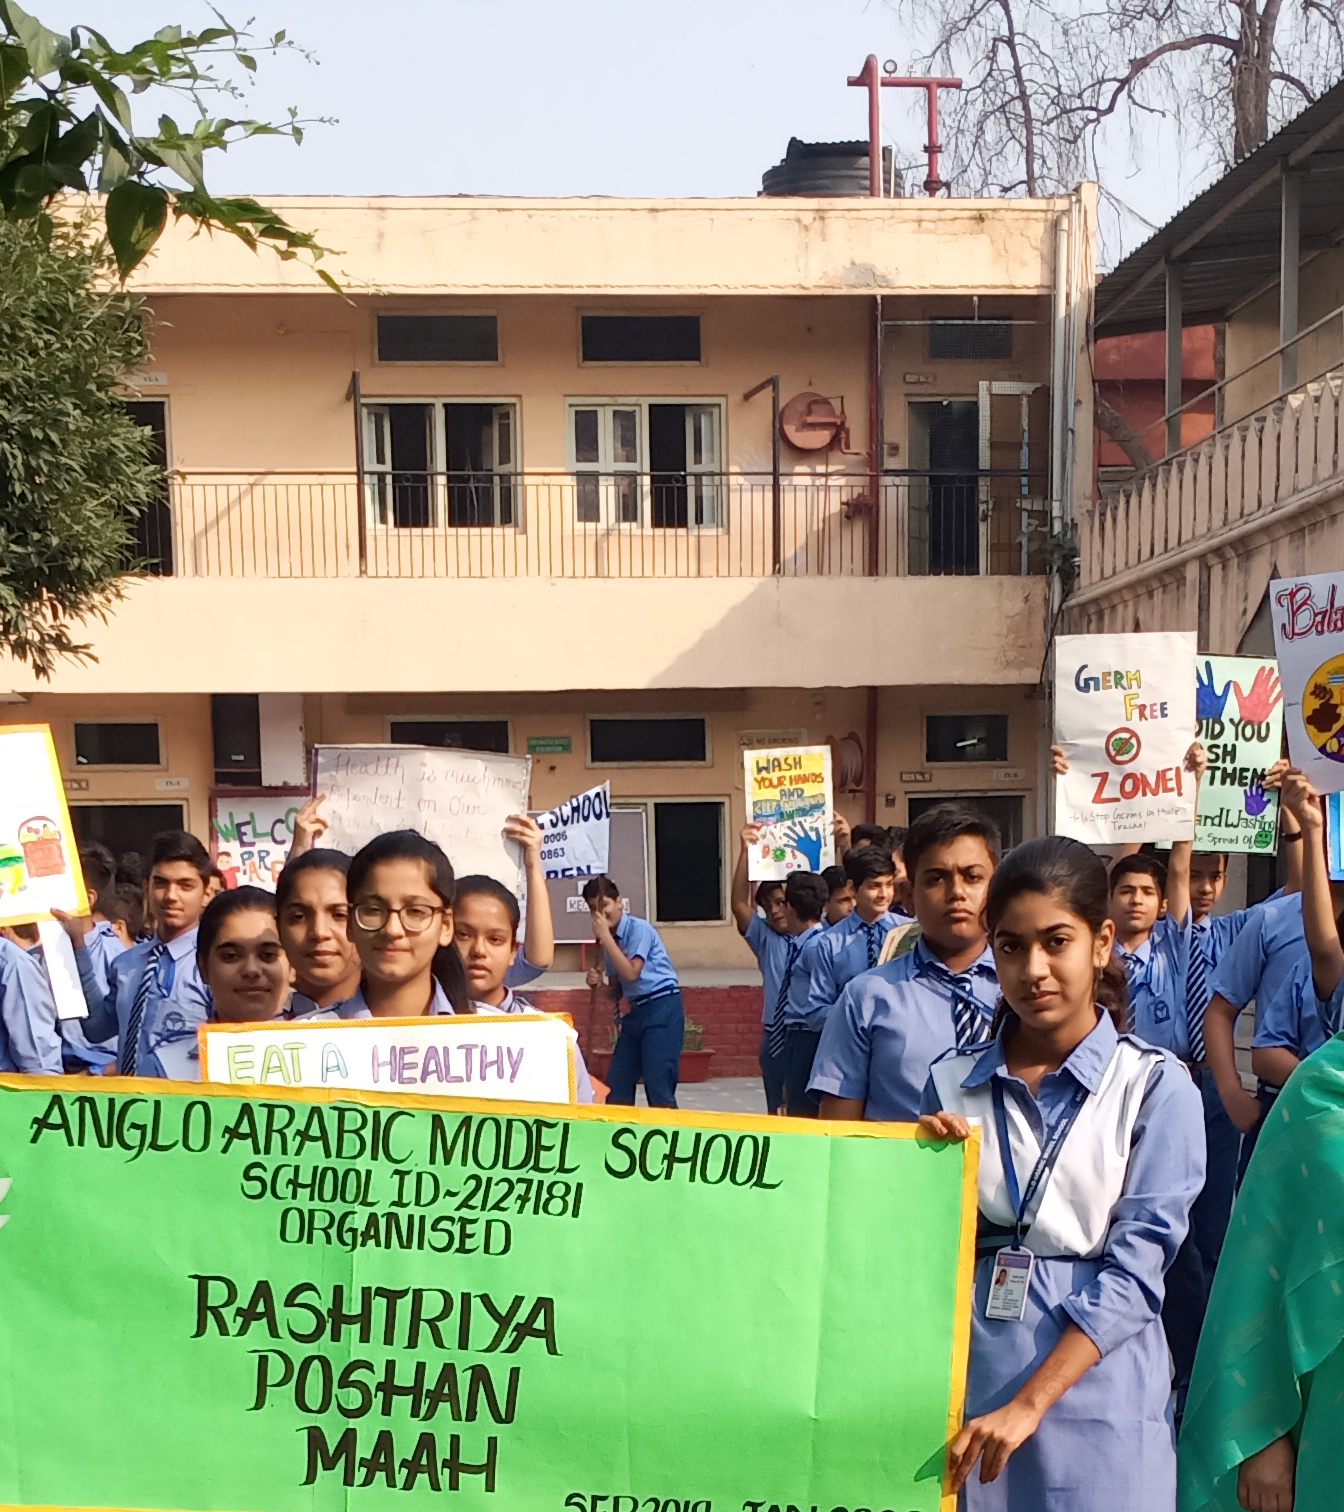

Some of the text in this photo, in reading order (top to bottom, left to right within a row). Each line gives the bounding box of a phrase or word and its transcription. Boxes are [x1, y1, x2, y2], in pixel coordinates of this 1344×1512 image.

[1075, 664, 1141, 693] GERM
[1123, 693, 1168, 722] FREE
[1229, 718, 1270, 743] YOU
[756, 756, 803, 775] WASH
[1207, 743, 1236, 764] SH
[334, 753, 405, 784] Health
[417, 763, 437, 783] is
[443, 766, 490, 795] much
[754, 772, 824, 790] YOUR HANDS
[1091, 766, 1183, 804] ZONE!
[416, 797, 437, 813] on
[550, 790, 611, 828] SCHOOL
[780, 788, 804, 800] AND
[212, 807, 300, 848] WELCO
[227, 1042, 524, 1084] EAT A HEALTHY
[30, 1094, 783, 1190] ANGLO ARABIC MODEL SCHOOL
[241, 1162, 380, 1207] SCHOOL
[279, 1207, 512, 1256] ORGANISED
[188, 1274, 563, 1356] RASHTRIYA
[246, 1349, 521, 1425] POSHAN
[296, 1426, 498, 1493] MAAH
